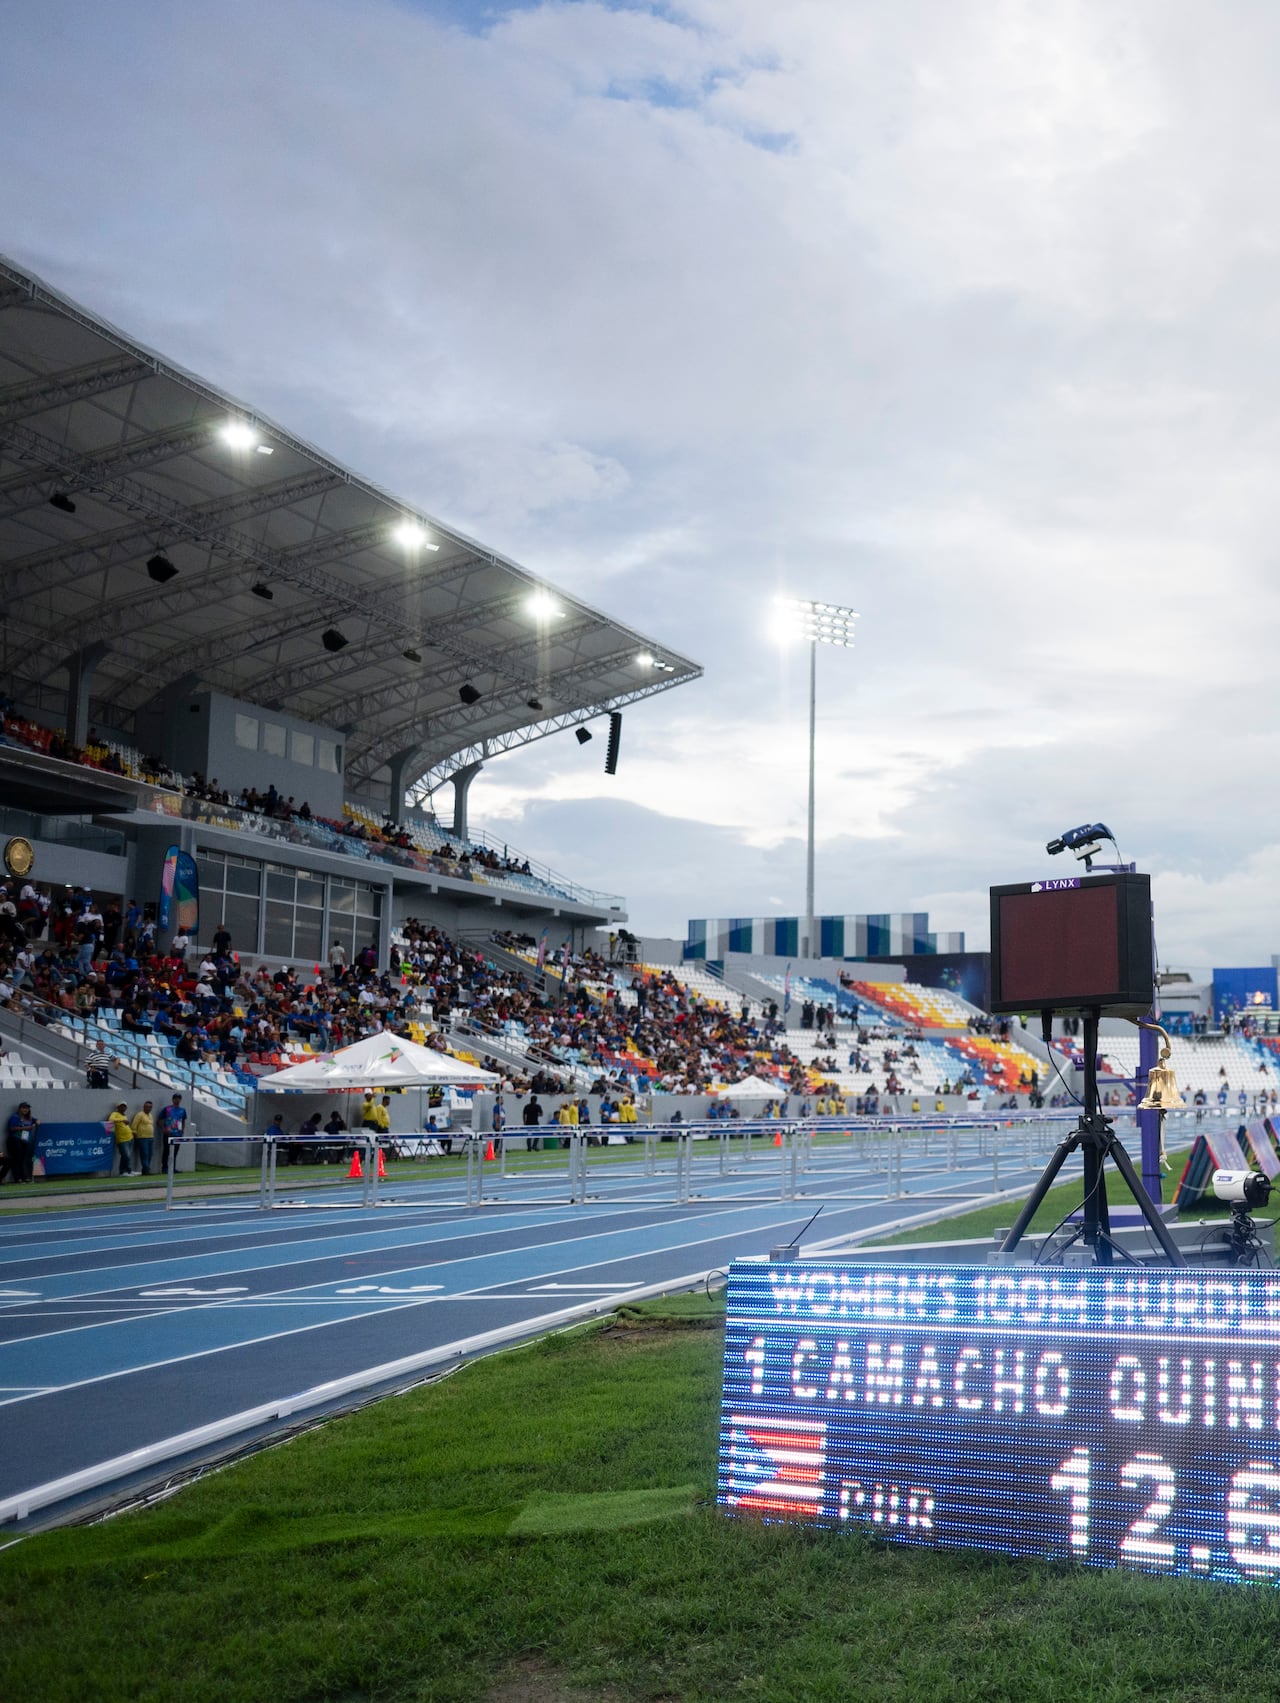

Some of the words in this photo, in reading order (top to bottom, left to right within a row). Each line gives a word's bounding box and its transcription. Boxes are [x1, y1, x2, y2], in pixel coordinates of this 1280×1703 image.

[1046, 879, 1075, 890] LYNX
[972, 1277, 1089, 1324] 100M
[745, 1337, 765, 1394] 1
[792, 1340, 1069, 1416] CAMACHO
